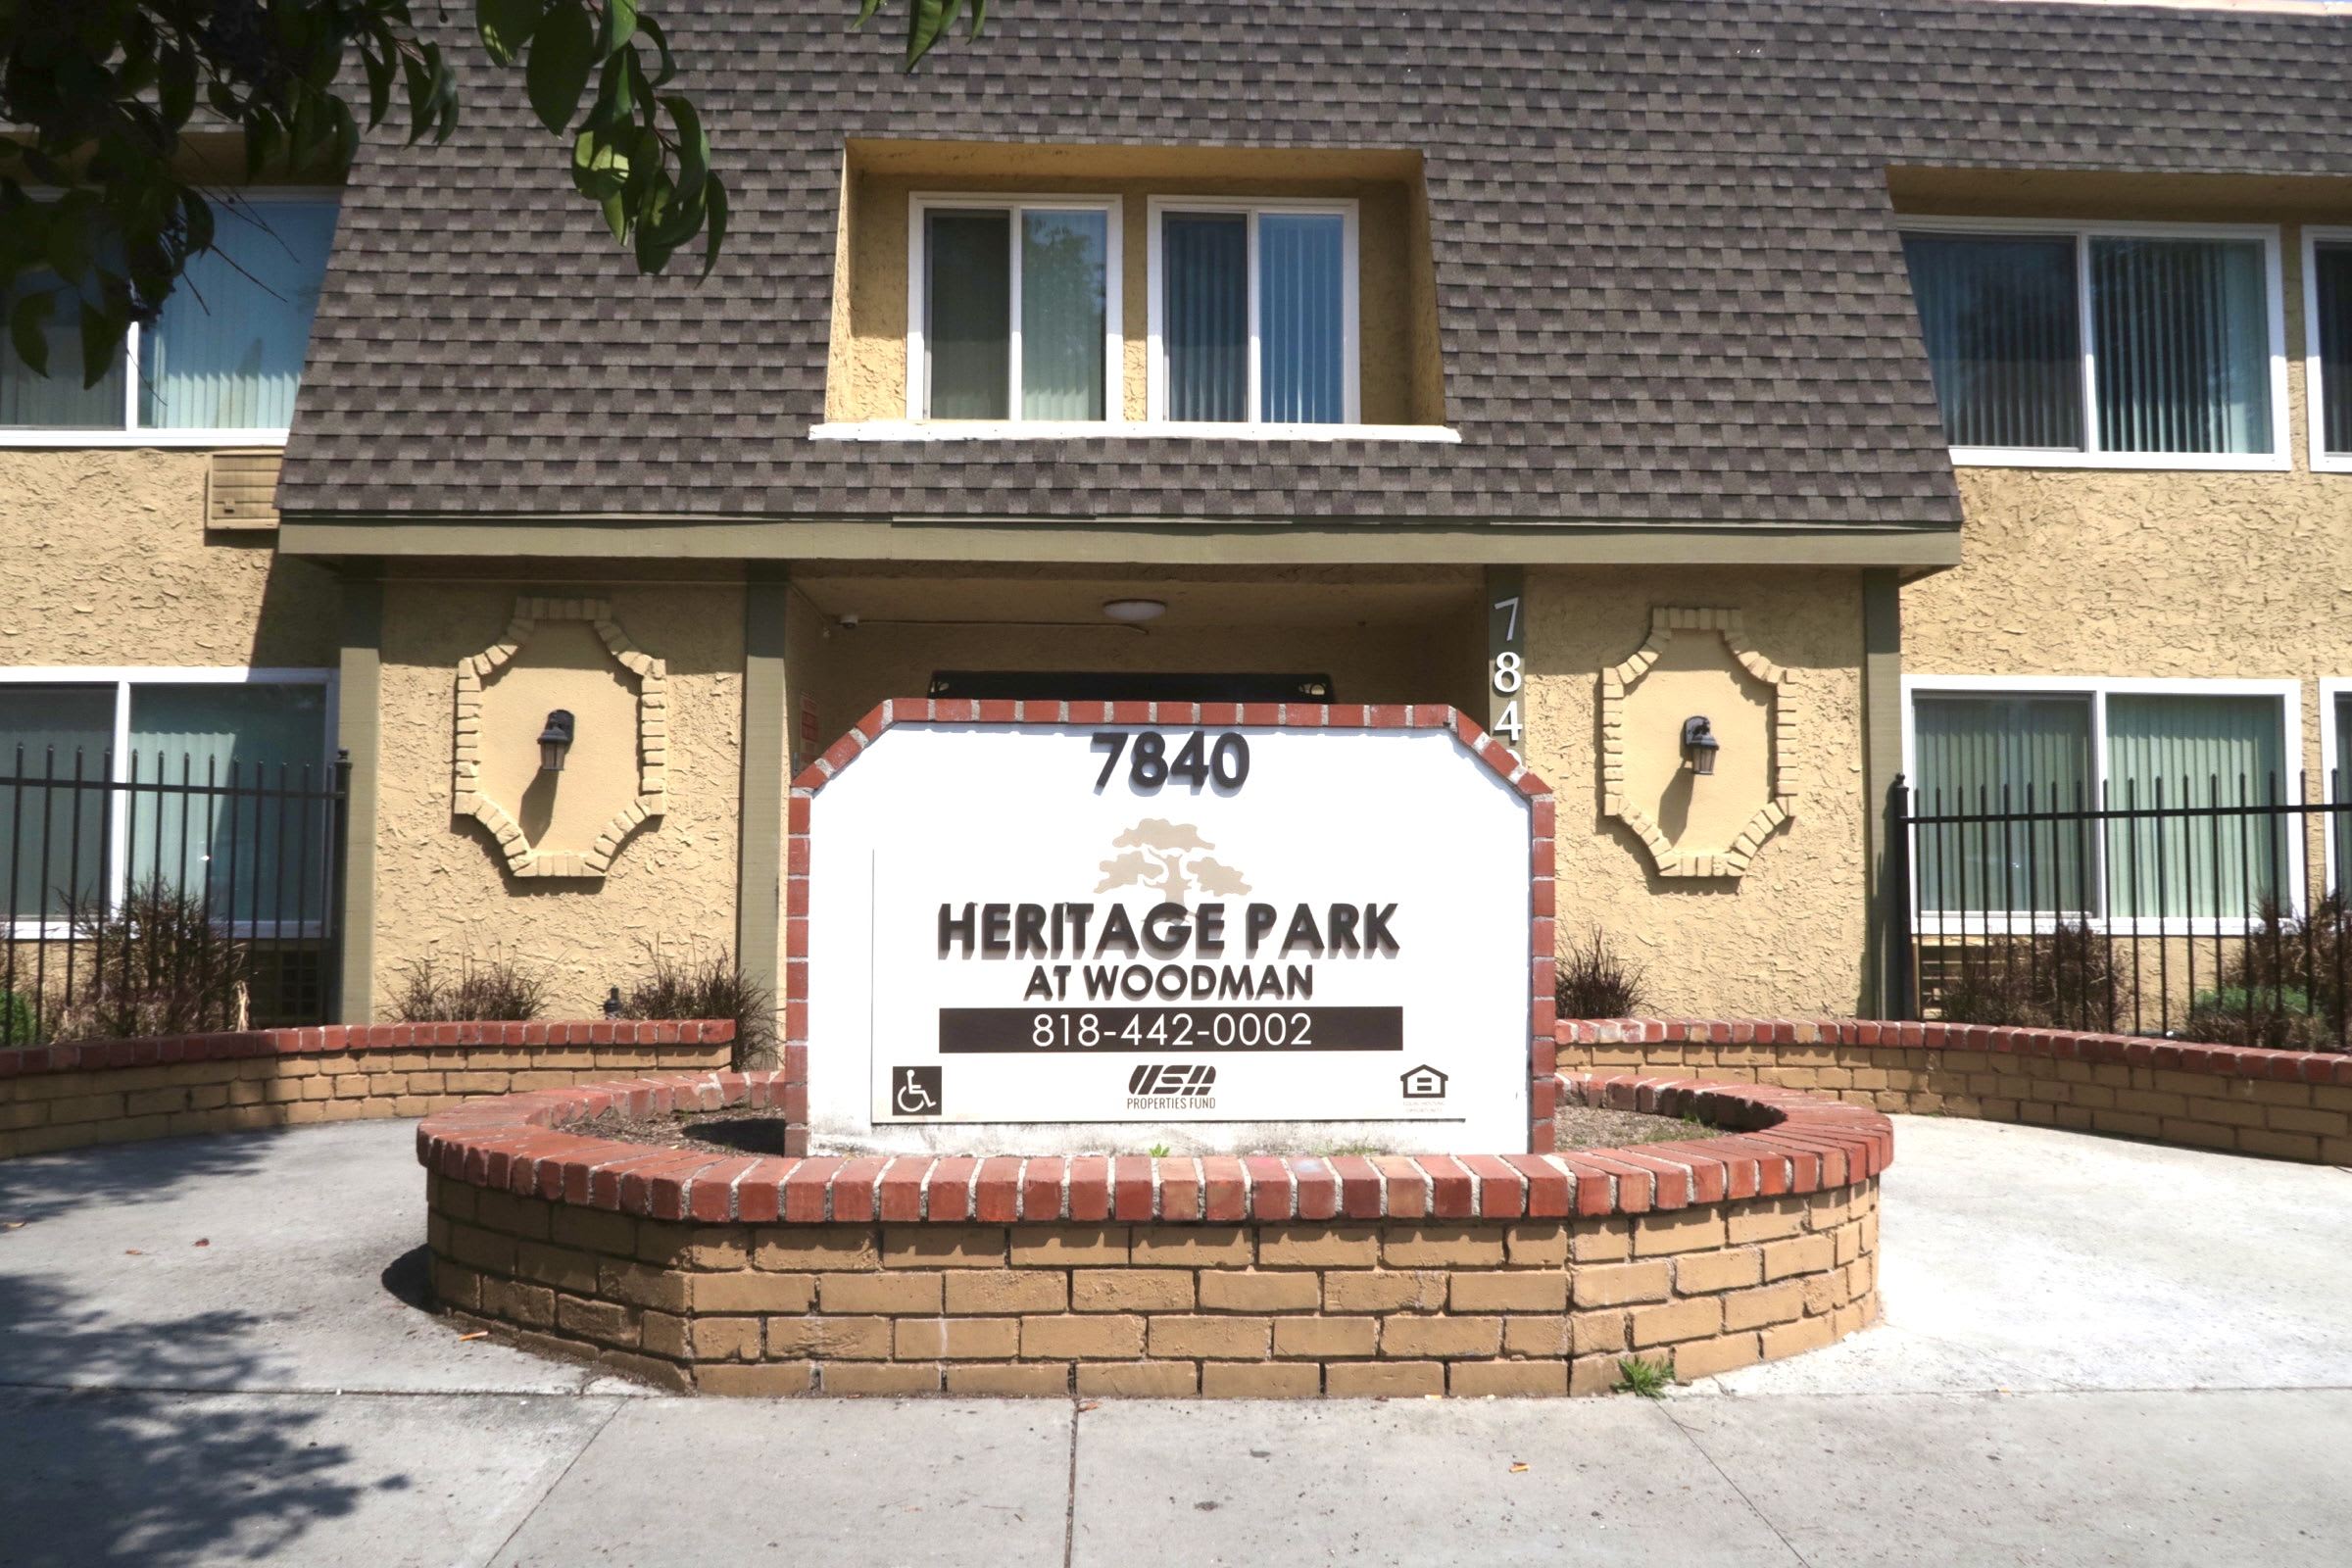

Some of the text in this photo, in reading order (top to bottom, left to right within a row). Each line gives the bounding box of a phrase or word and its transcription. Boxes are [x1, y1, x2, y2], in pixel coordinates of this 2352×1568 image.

[1091, 730, 1250, 789] 7840
[938, 902, 1400, 955] HERITAGE PARK
[1025, 963, 1313, 1001] AT WOODMAN
[1032, 1012, 1312, 1048] 818-442-0002
[1128, 1064, 1217, 1096] USA
[1126, 1097, 1216, 1110] PROPERTIES FUND
